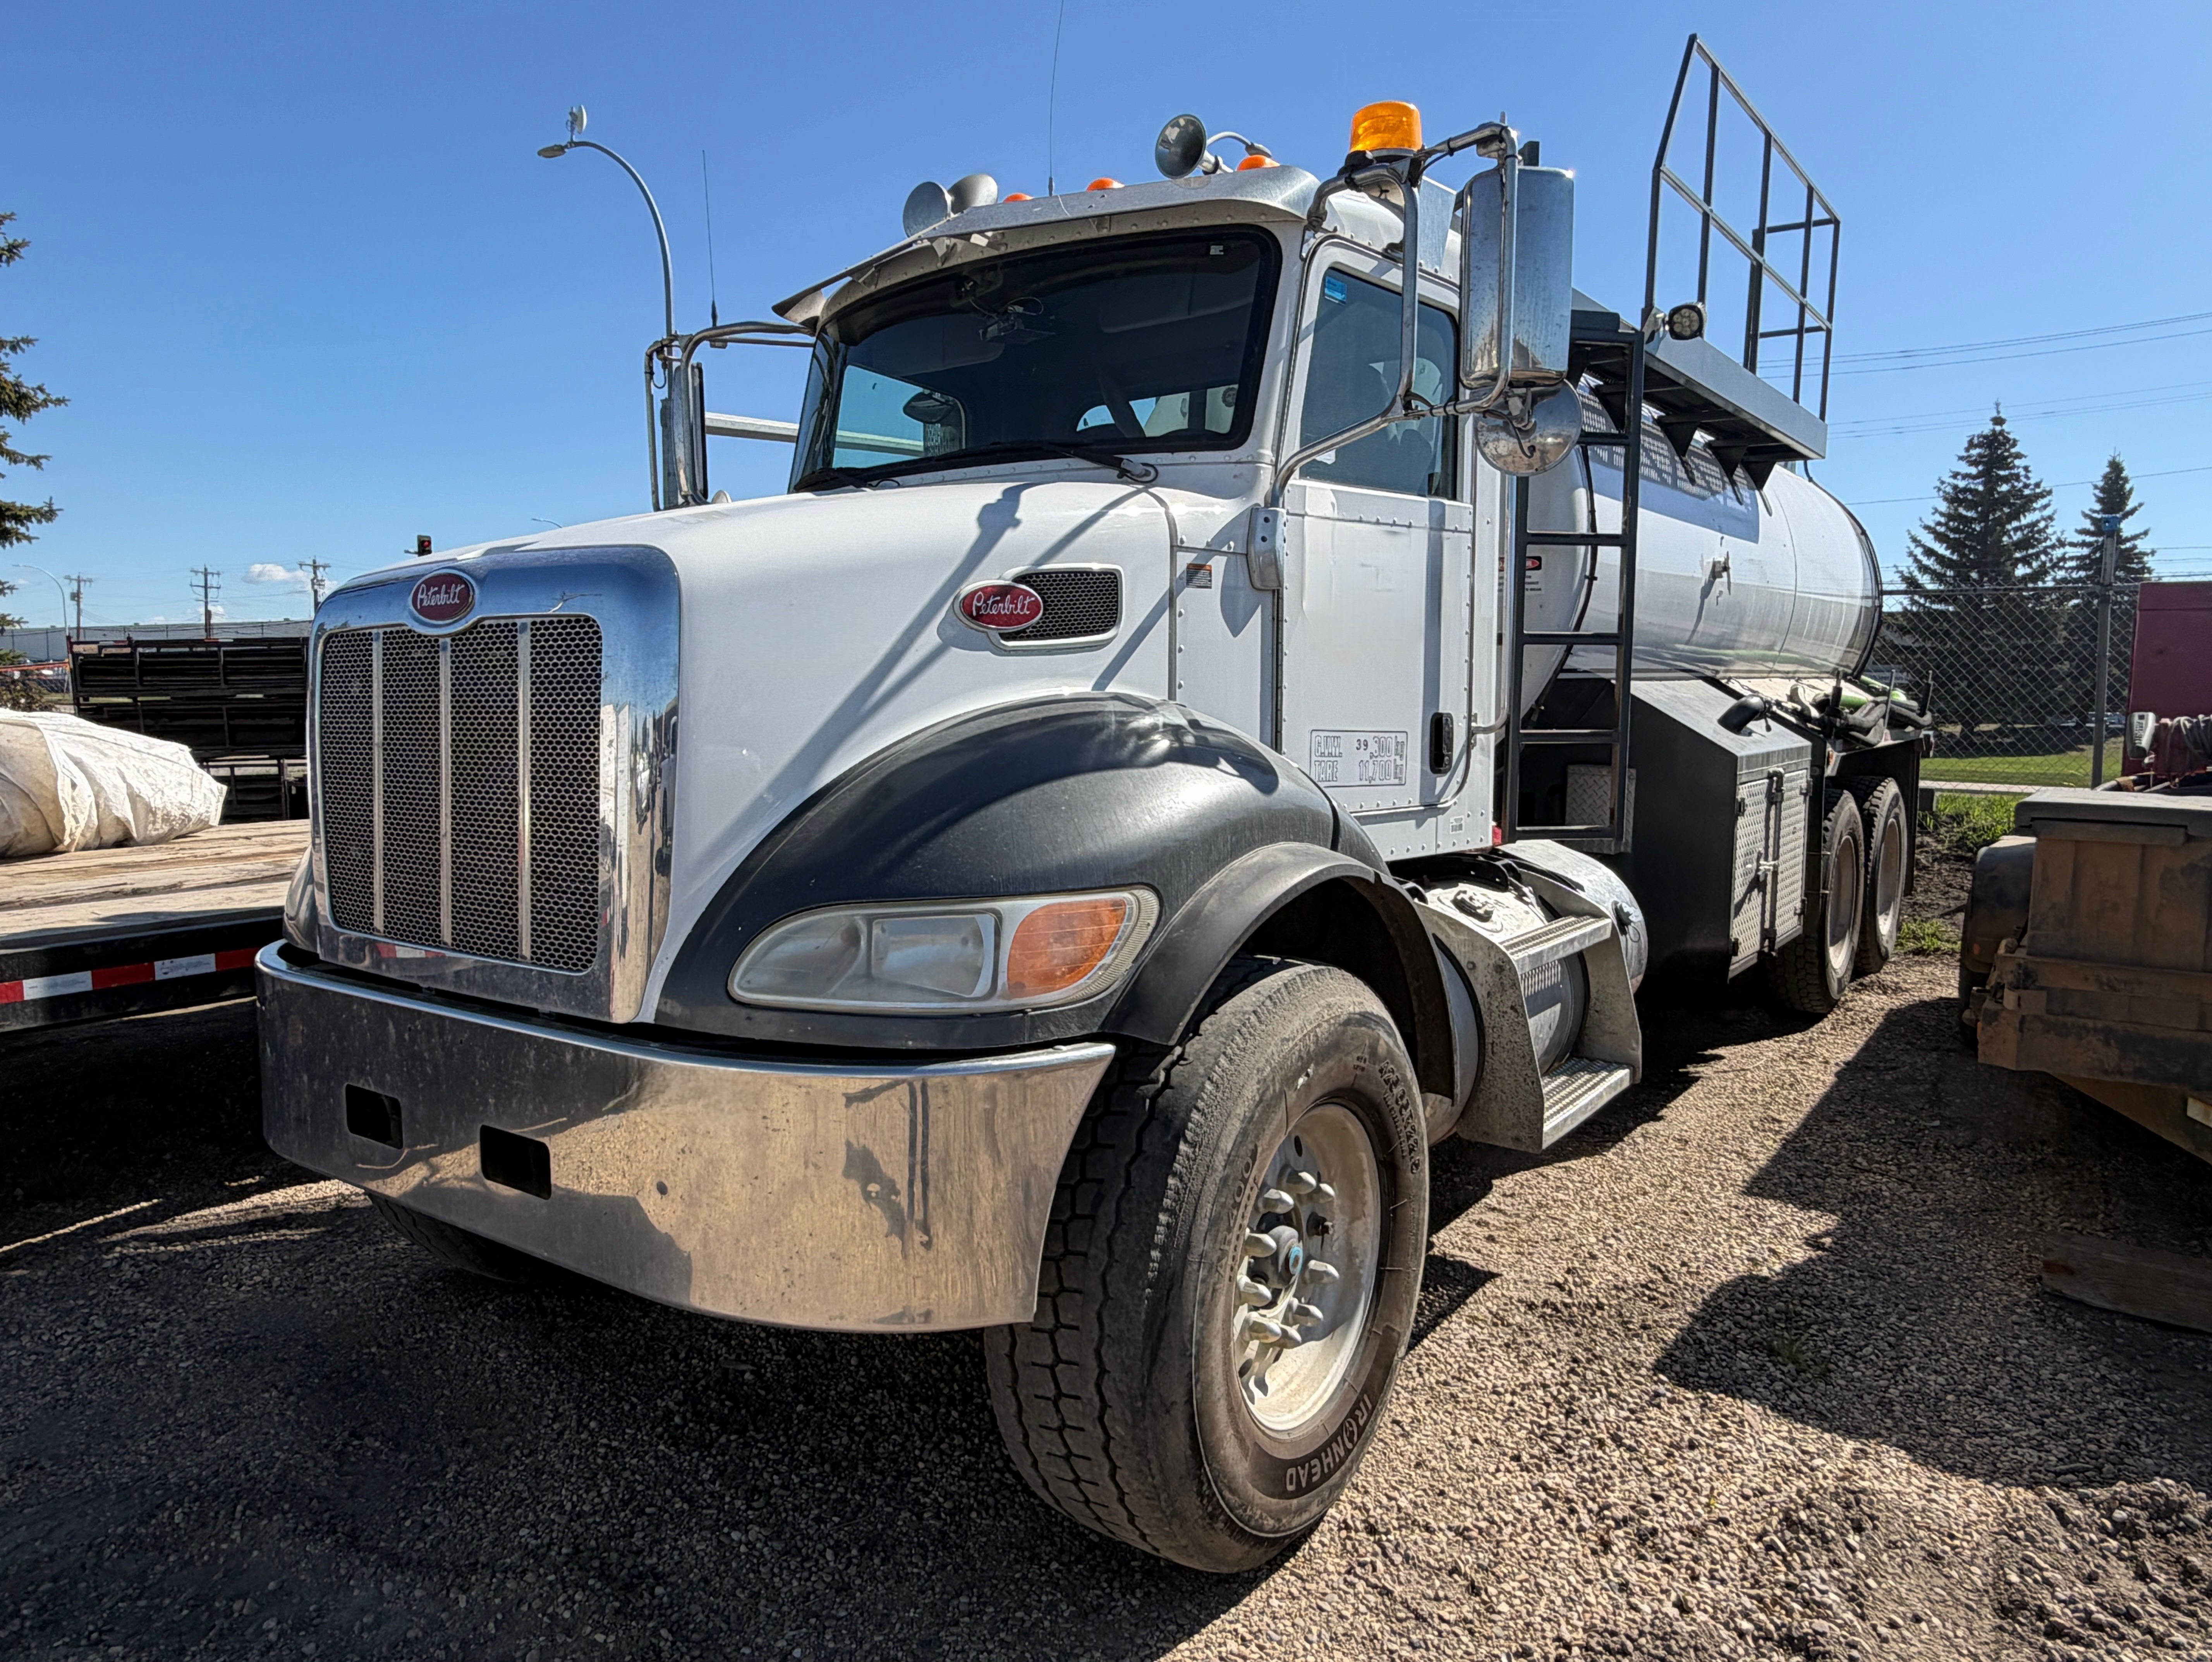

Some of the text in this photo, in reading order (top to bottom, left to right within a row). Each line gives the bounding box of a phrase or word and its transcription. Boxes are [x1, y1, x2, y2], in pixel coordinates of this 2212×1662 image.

[417, 583, 465, 610] Peterbilt
[972, 591, 1036, 617] Peterbilt
[1394, 735, 1405, 761] kg
[1314, 758, 1404, 784] TARE 11,700 kg
[1286, 1394, 1372, 1491] IRONHEAD
